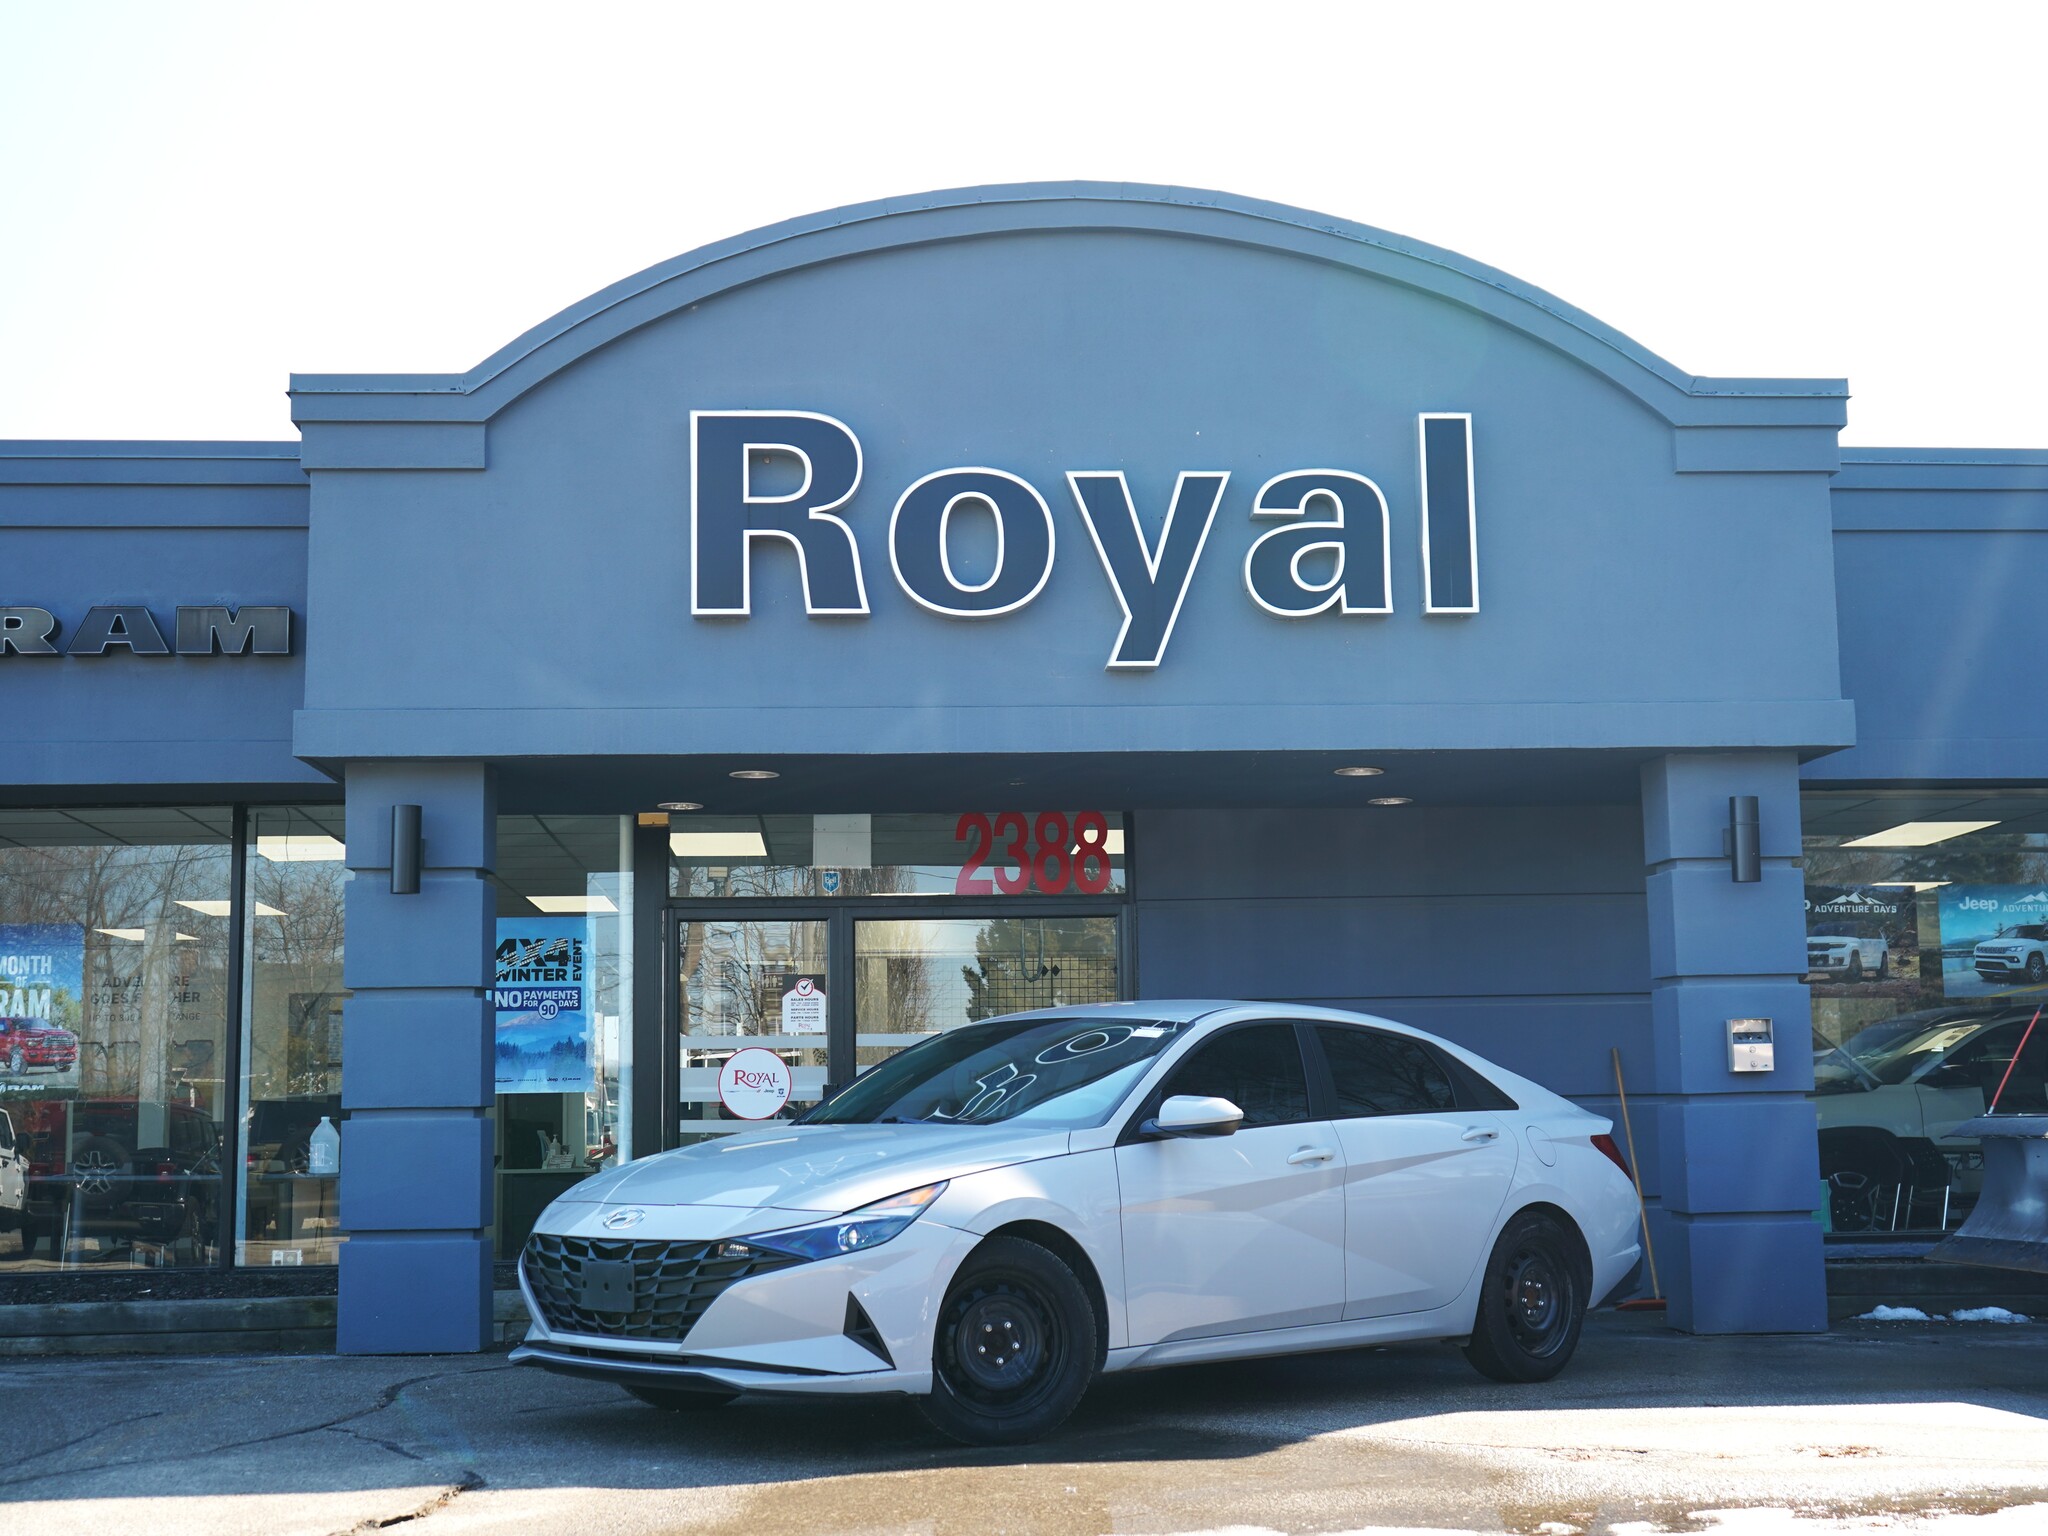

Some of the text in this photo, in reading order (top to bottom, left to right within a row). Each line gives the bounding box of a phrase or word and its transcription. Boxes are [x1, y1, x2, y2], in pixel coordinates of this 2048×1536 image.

[688, 408, 1482, 671] Royal
[0, 606, 292, 655] RAM
[955, 810, 1111, 896] 2388
[1815, 905, 1897, 913] ADVENTURE DAYS
[1959, 896, 1998, 912] Jeep
[573, 938, 582, 981] EVENT
[15, 976, 27, 988] OF
[496, 969, 567, 981] WINTER
[91, 992, 128, 1004] GOES
[495, 991, 522, 1007] NO
[523, 990, 578, 999] PAYMENTS
[541, 1004, 556, 1016] 90
[734, 1069, 779, 1089] ROYAL
